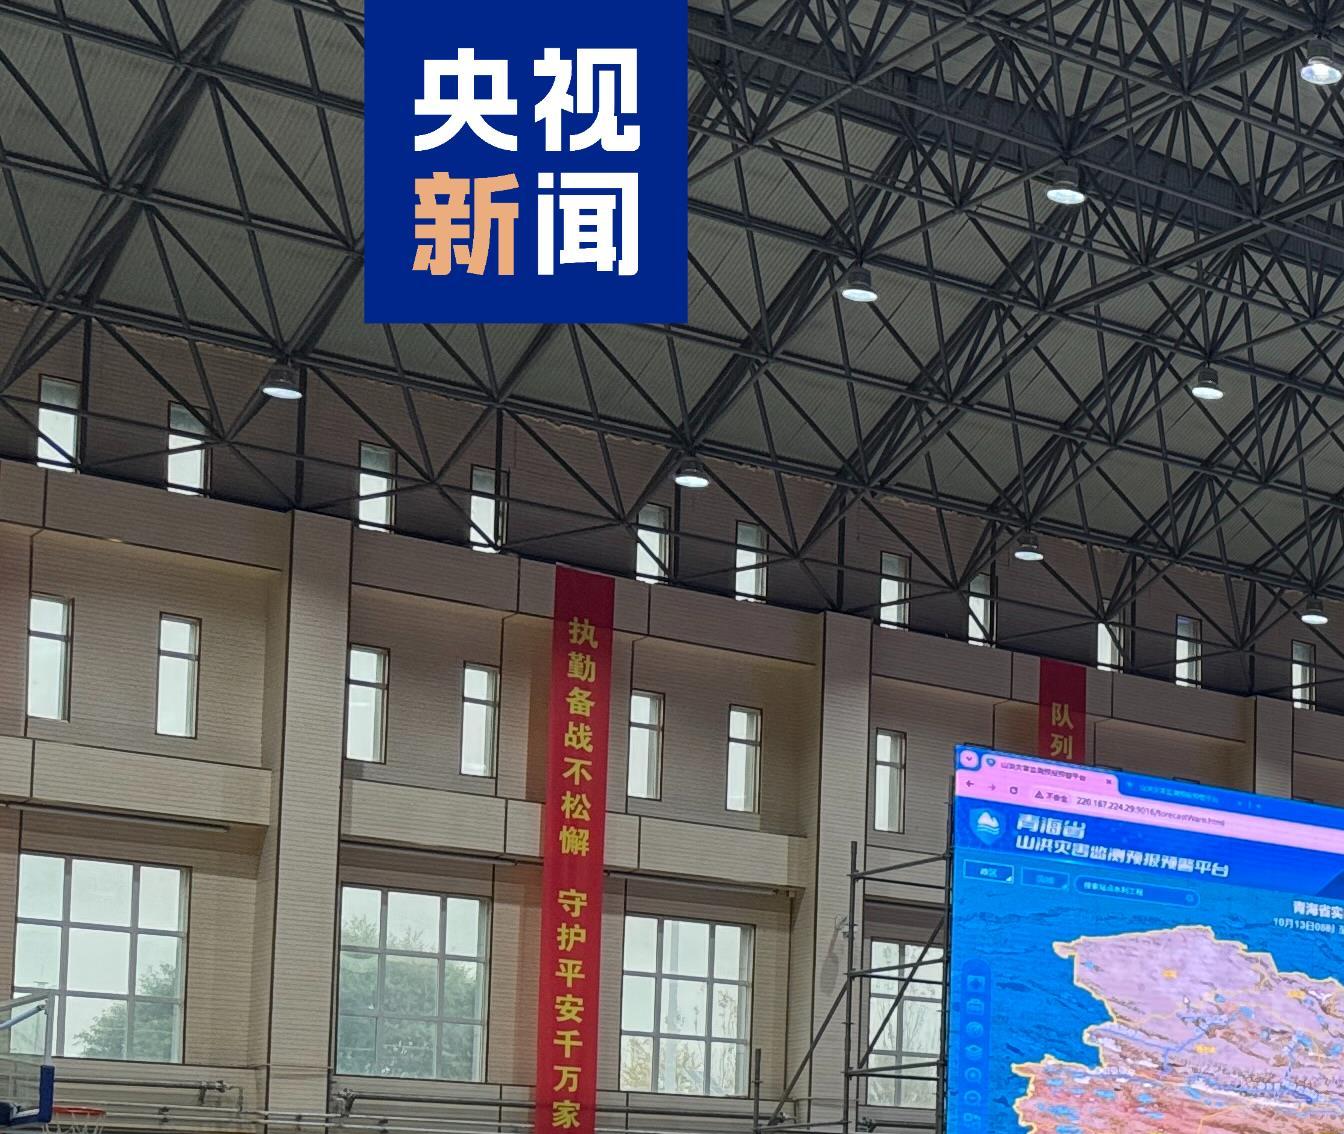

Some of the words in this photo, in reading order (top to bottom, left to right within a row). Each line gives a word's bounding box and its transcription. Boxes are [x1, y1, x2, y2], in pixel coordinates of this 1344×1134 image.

[558, 616, 599, 857] 执勤备战不松懈
[1050, 702, 1074, 760] 队列
[1016, 813, 1086, 840] 青海省
[1015, 834, 1230, 878] 山洪灾害监测预报预警平台
[551, 888, 588, 1130] 守护平安千万家
